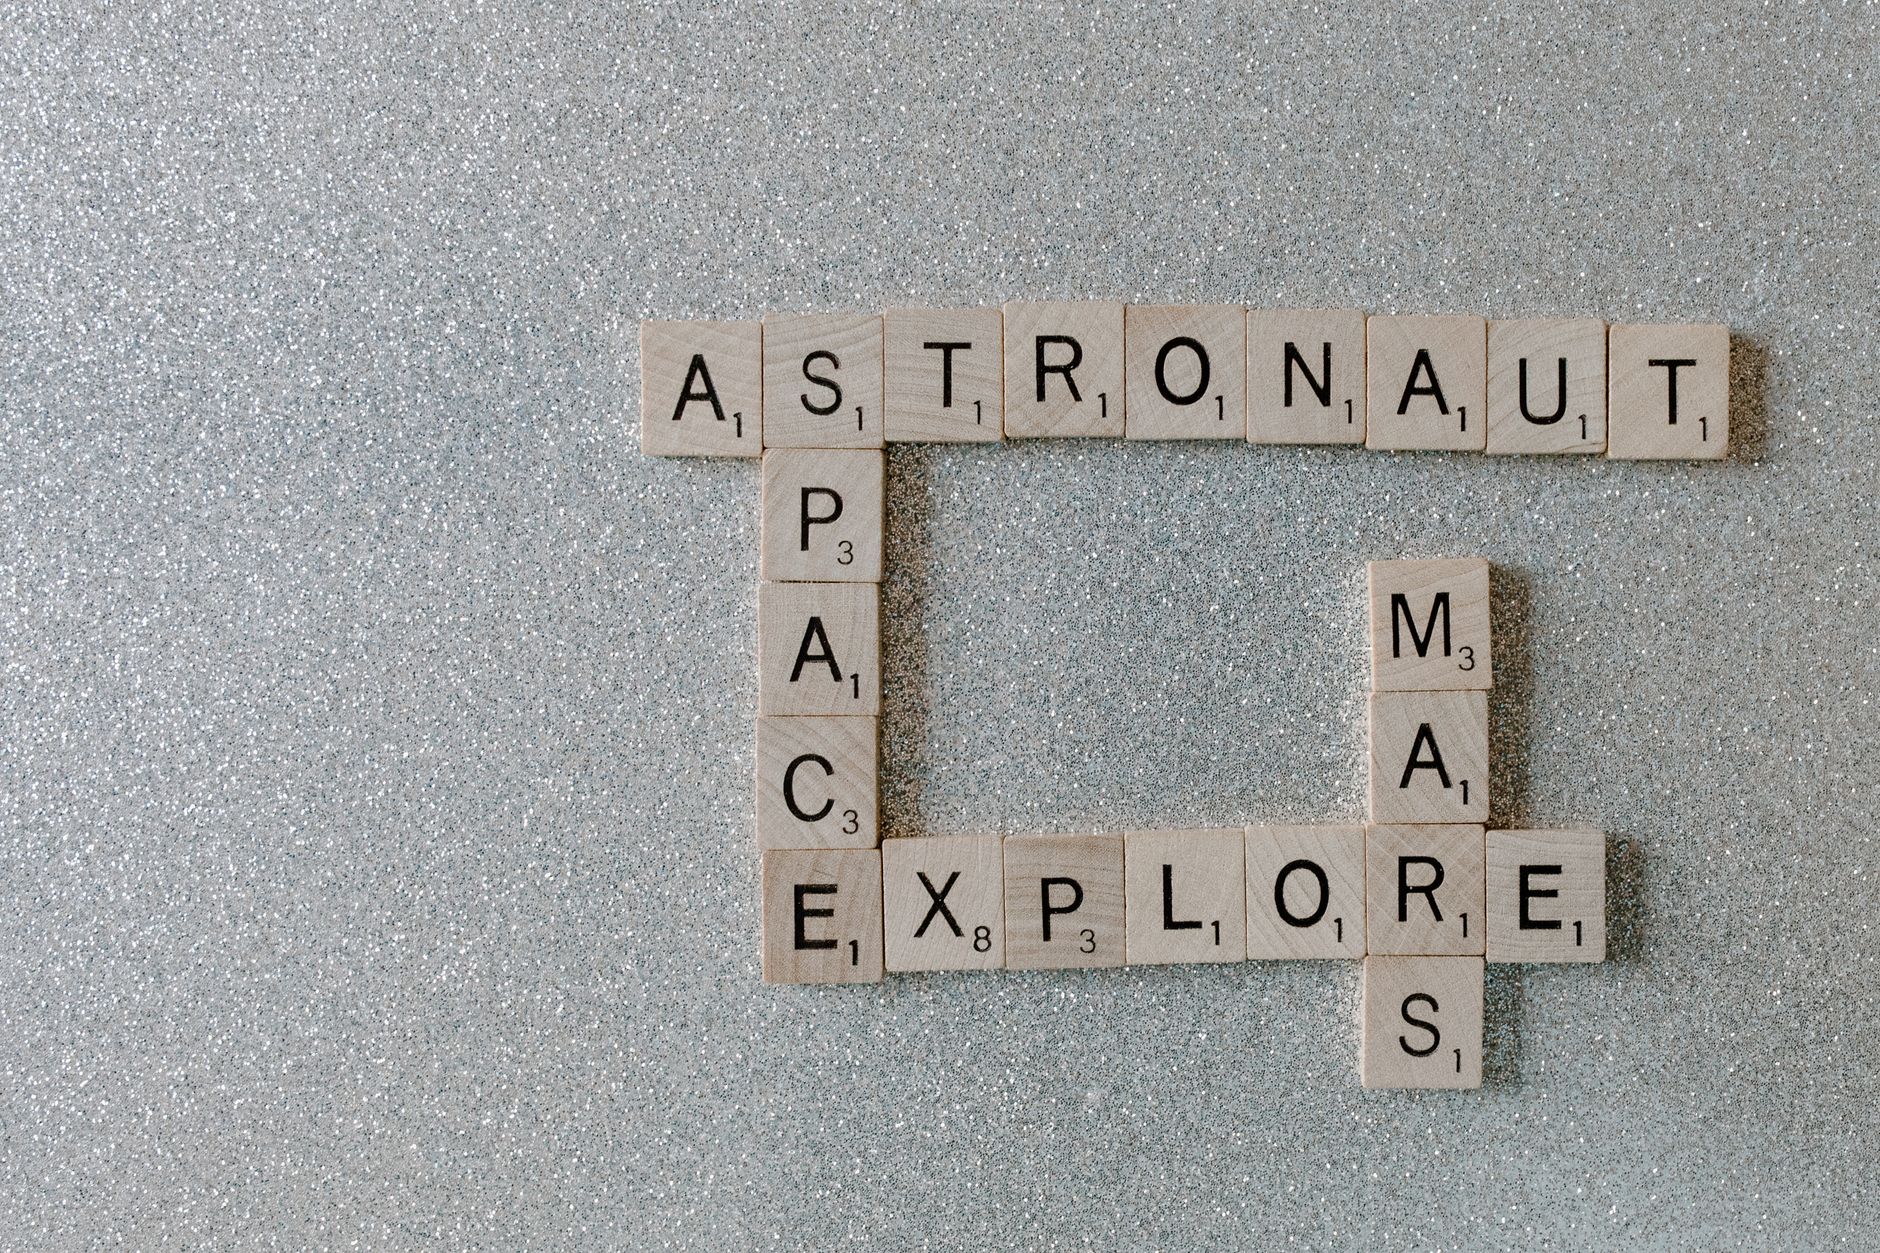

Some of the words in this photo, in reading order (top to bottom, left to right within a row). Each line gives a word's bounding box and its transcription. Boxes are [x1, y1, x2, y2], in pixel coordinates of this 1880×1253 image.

[671, 334, 1697, 426] ASTRONAUT
[855, 406, 863, 432] 1
[973, 399, 982, 425] 1
[1097, 392, 1107, 419] 1
[1214, 394, 1224, 421] 1
[1344, 398, 1353, 425] 1
[1457, 405, 1467, 433] 1
[733, 412, 742, 438] 1
[1578, 413, 1587, 440] 1
[1698, 416, 1707, 442] 1
[837, 540, 854, 566] 3
[1458, 645, 1476, 672] 3
[849, 672, 860, 700] 1
[1459, 779, 1469, 806] 1
[842, 809, 860, 835] 3
[793, 855, 1563, 951] EXPLORE
[972, 925, 992, 953] 8
[1210, 920, 1221, 946] 1
[1333, 917, 1343, 943] 1
[1458, 912, 1468, 939] 1
[1572, 920, 1583, 947] 1
[848, 939, 859, 967] 1
[1079, 928, 1097, 954] 3
[1453, 1048, 1462, 1074] 1
